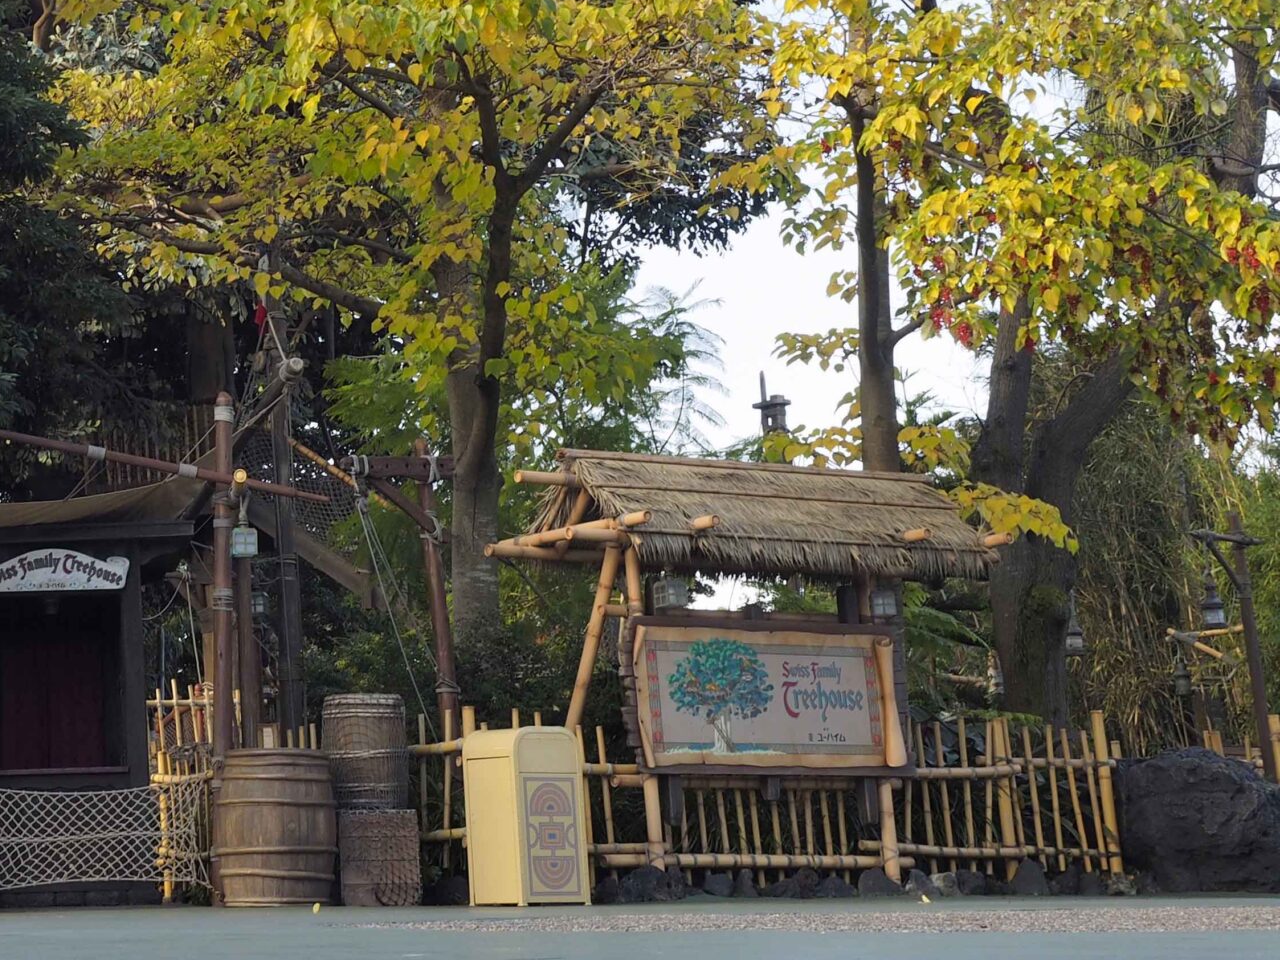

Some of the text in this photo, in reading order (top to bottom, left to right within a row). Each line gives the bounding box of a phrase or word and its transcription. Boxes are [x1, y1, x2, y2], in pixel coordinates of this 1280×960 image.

[18, 552, 62, 581] Family
[62, 553, 124, 586] Treehouse
[782, 661, 842, 685] Swiss Family
[781, 681, 863, 722] Treehouse
